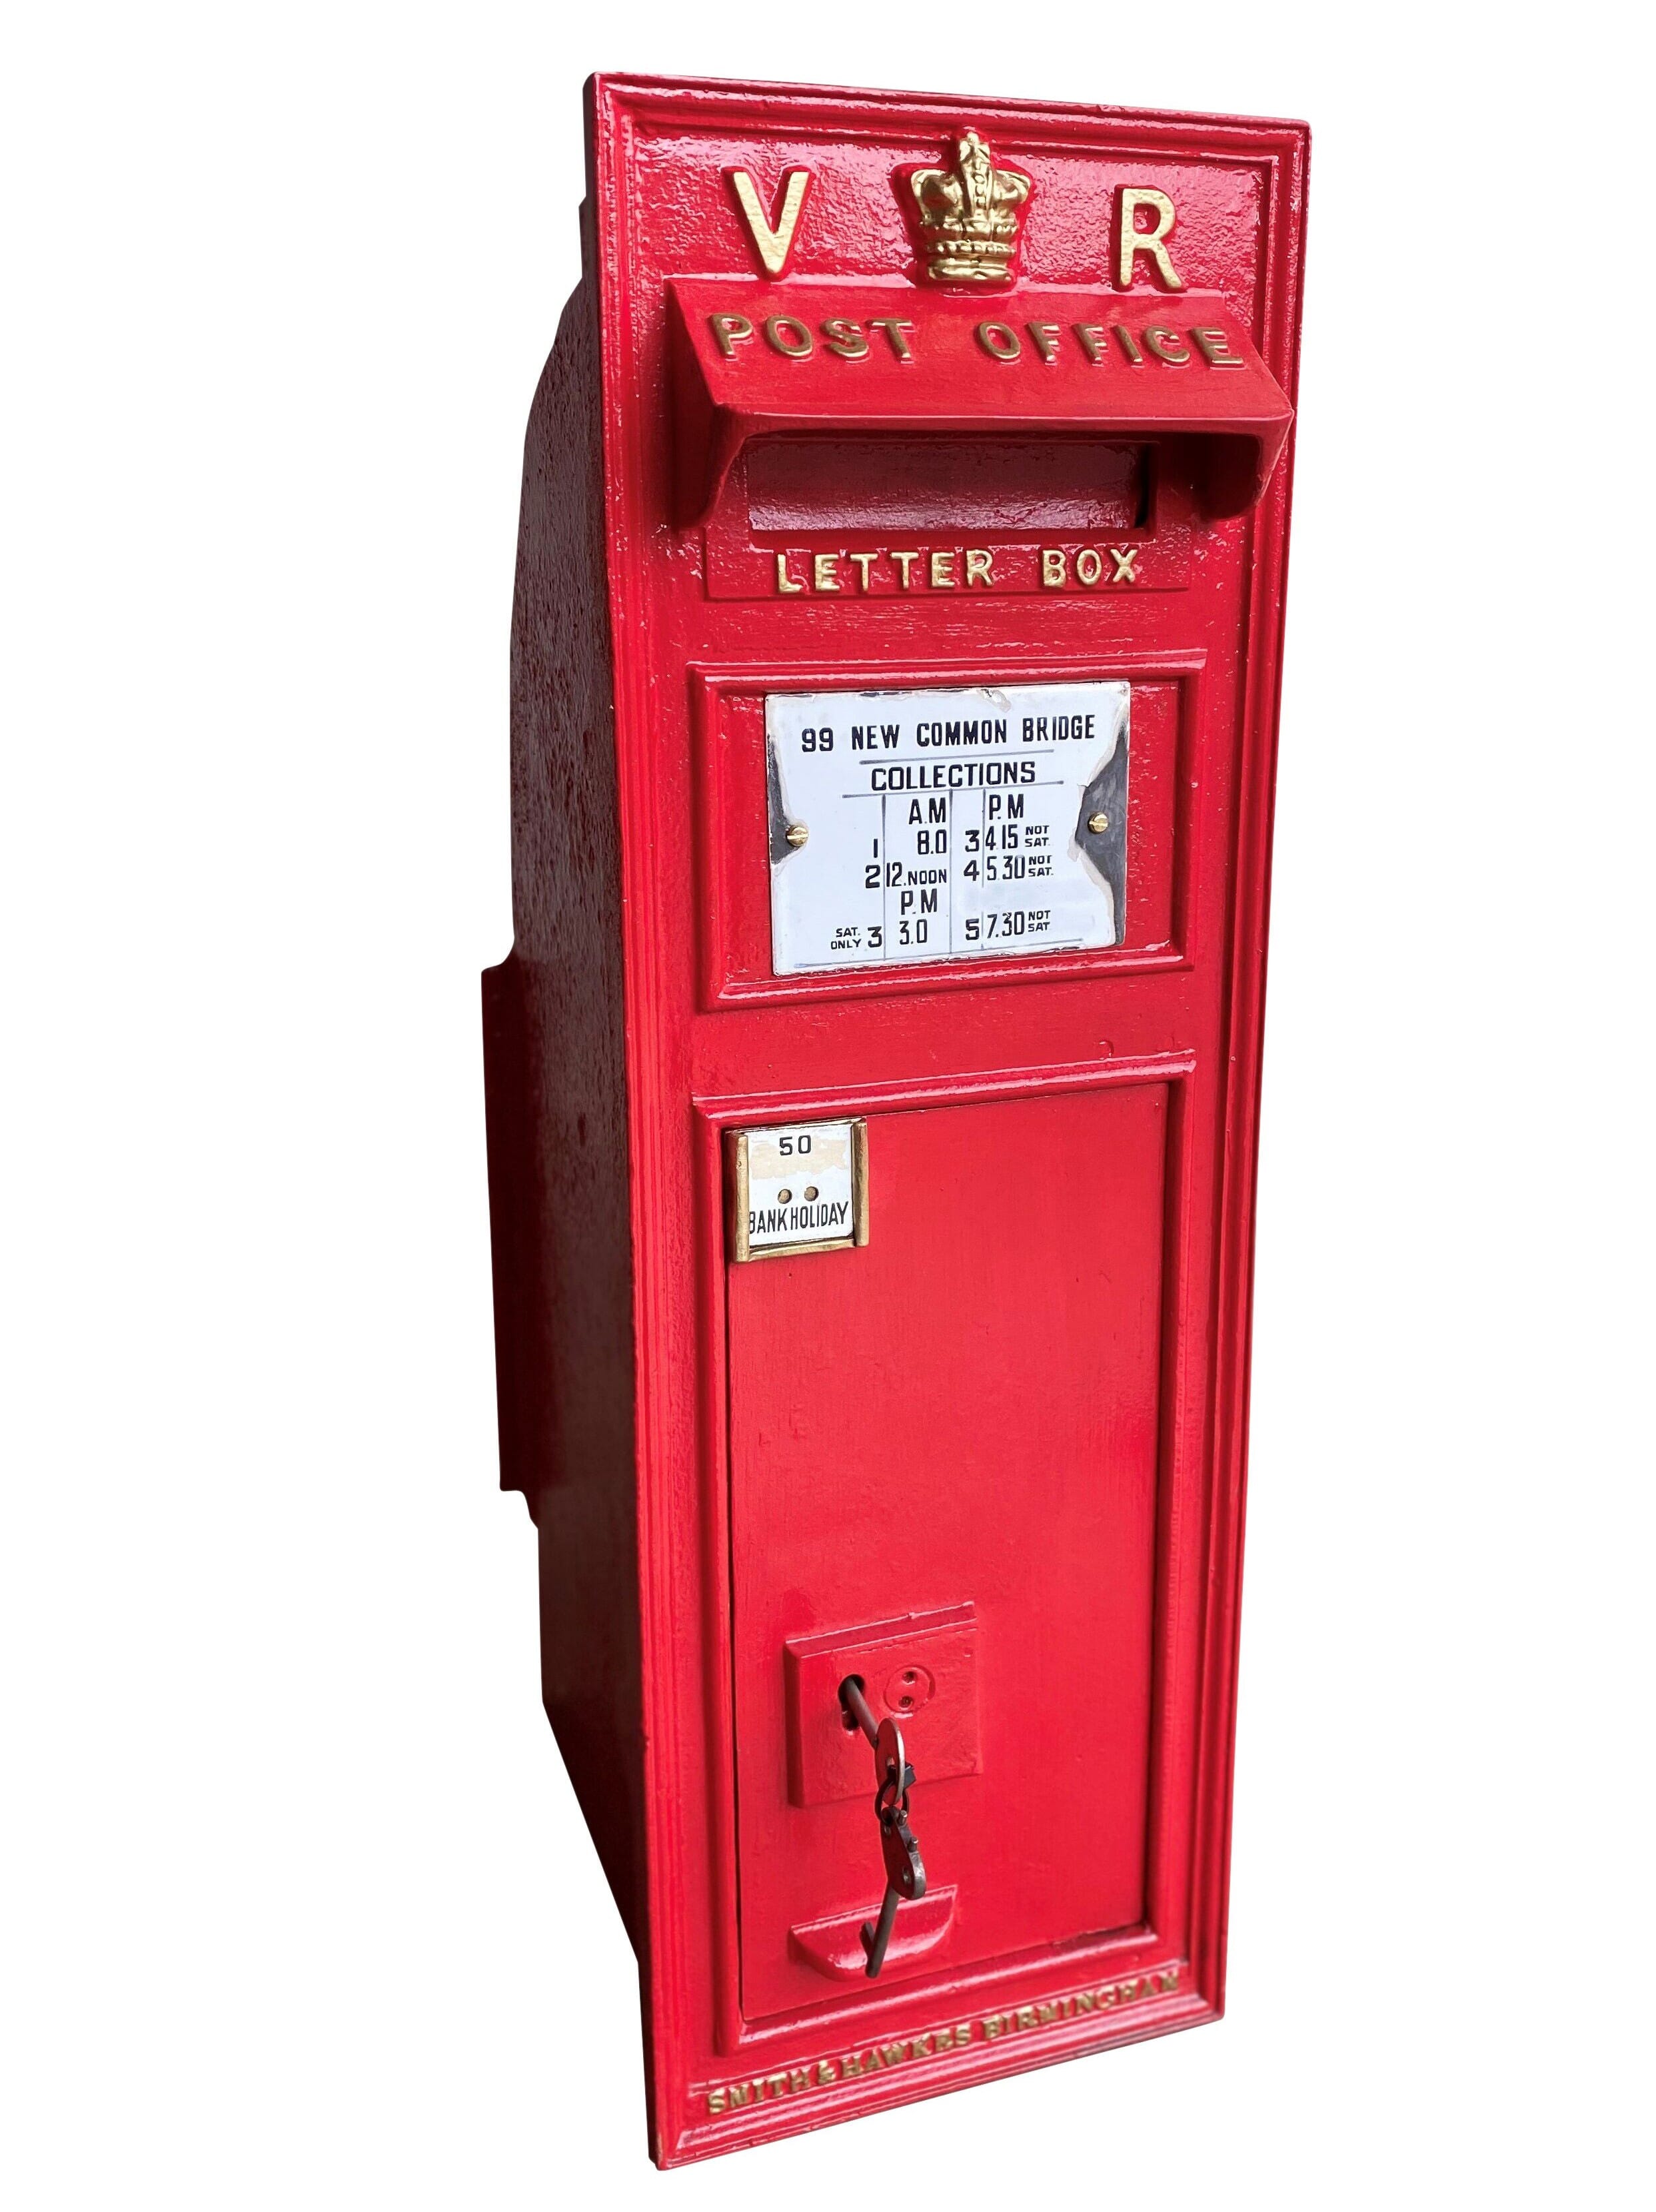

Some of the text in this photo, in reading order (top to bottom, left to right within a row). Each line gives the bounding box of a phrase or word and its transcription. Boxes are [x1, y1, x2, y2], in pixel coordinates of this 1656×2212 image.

[731, 171, 810, 275] V
[1122, 188, 1182, 289] R
[709, 313, 1243, 366] POST OFFICE
[776, 548, 1138, 593] LETTER BOX
[801, 714, 1095, 753] 99 NEW COMMON BRIDGE
[871, 761, 1036, 792] COLLECTIONS
[965, 830, 980, 852] 3
[1025, 825, 1050, 835] NOT
[873, 838, 878, 858] 1
[964, 859, 980, 881] 4
[1028, 855, 1052, 865] NOT
[865, 864, 881, 889] 2
[1028, 909, 1051, 921] NOT
[867, 925, 882, 948] 3
[965, 918, 980, 940] 5
[830, 939, 862, 950] ONLY
[779, 1135, 811, 1156] 50
[749, 1201, 849, 1234] BANK HOLIDAY
[984, 1968, 1179, 2039] BIRMINGHAM
